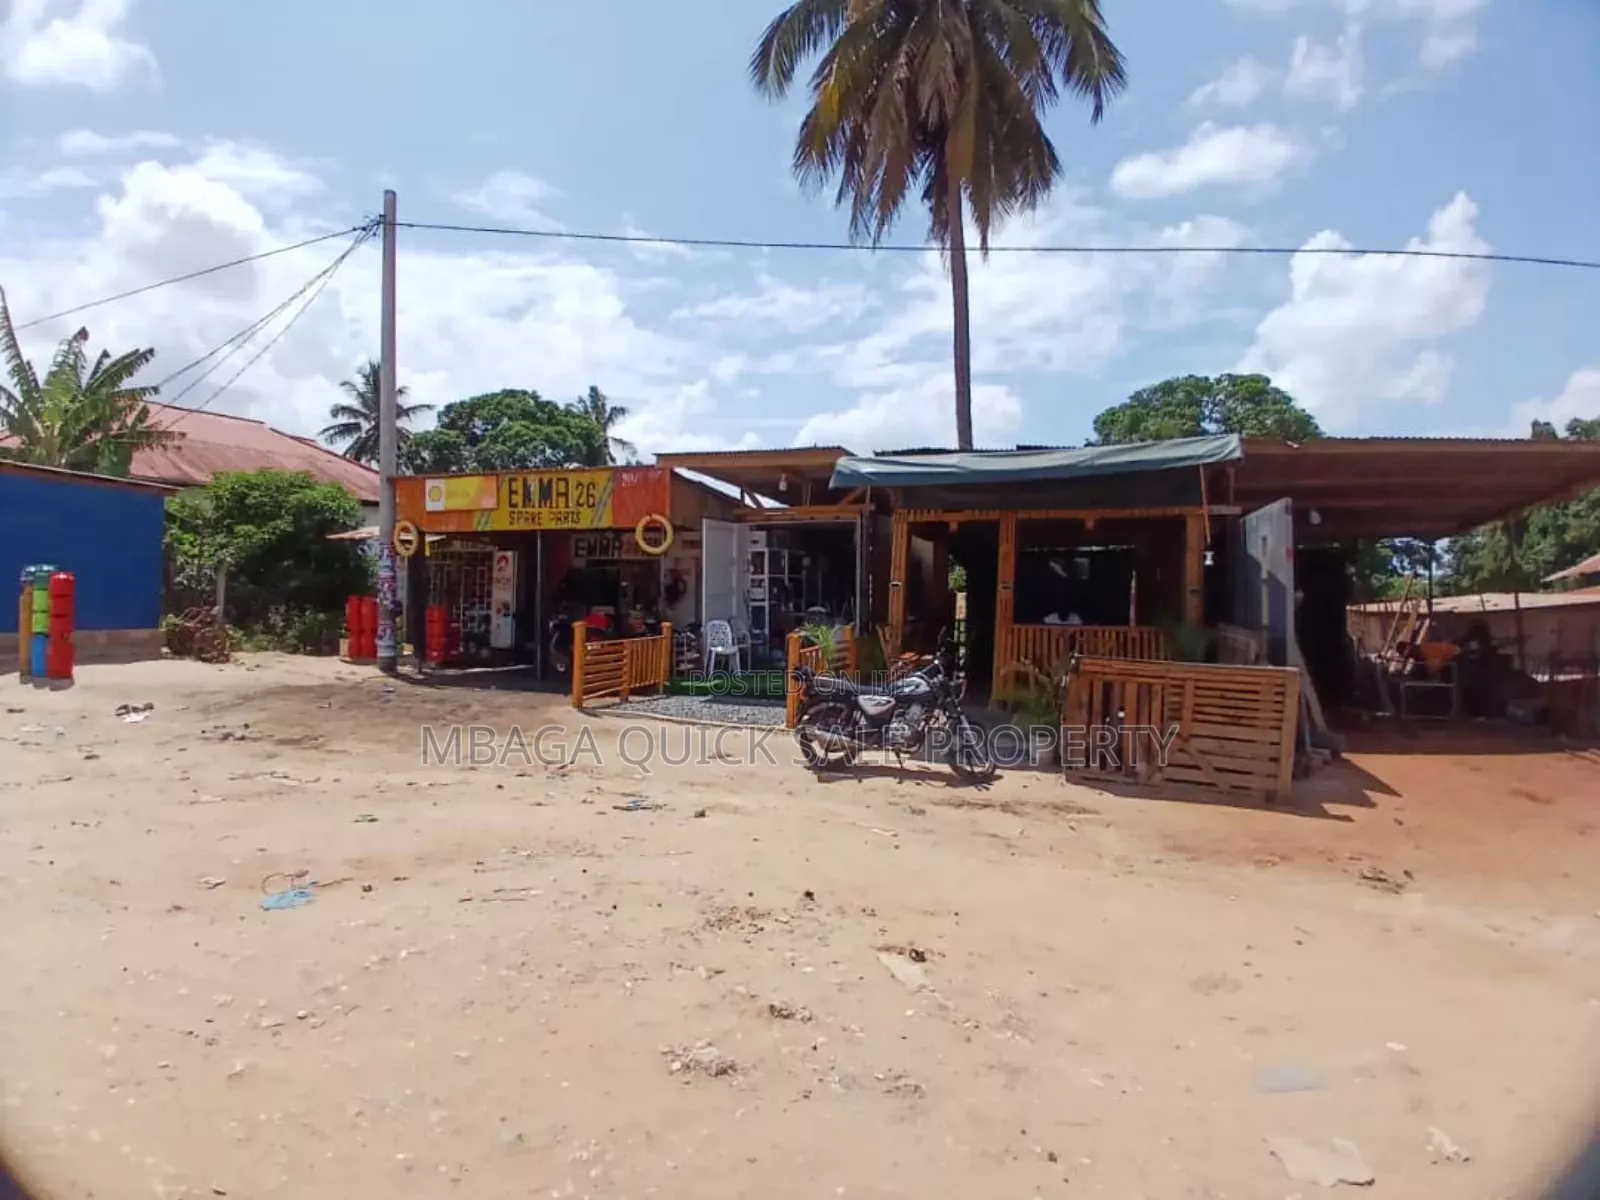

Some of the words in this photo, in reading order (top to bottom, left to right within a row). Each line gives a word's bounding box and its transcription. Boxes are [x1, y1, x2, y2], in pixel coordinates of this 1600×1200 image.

[508, 477, 570, 509] EMMA
[576, 481, 596, 509] 26
[509, 510, 543, 526] SPARE
[549, 510, 581, 525] PARTS
